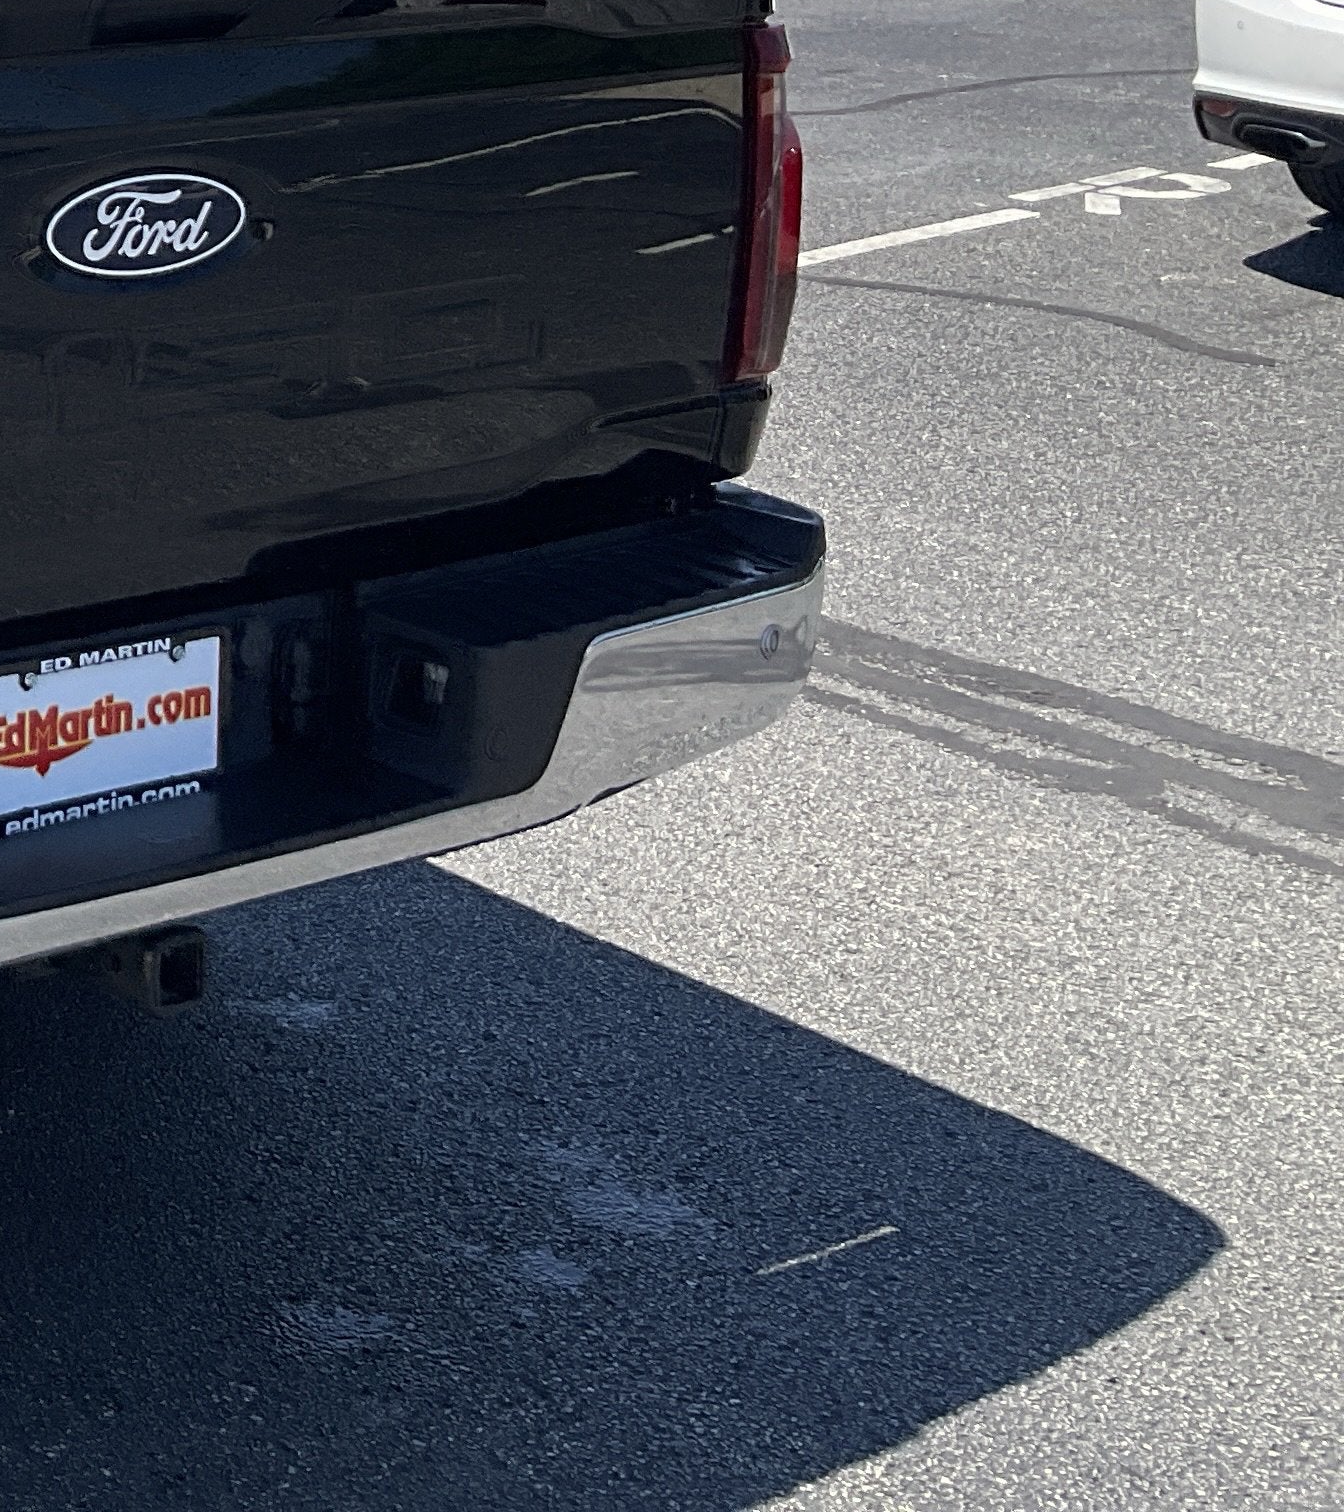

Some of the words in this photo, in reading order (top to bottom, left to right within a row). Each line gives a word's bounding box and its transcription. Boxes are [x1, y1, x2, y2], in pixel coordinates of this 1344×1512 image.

[82, 188, 212, 262] Ford
[40, 656, 72, 674] ED
[79, 638, 171, 667] MARTIN
[5, 780, 201, 837] edmartin.com
